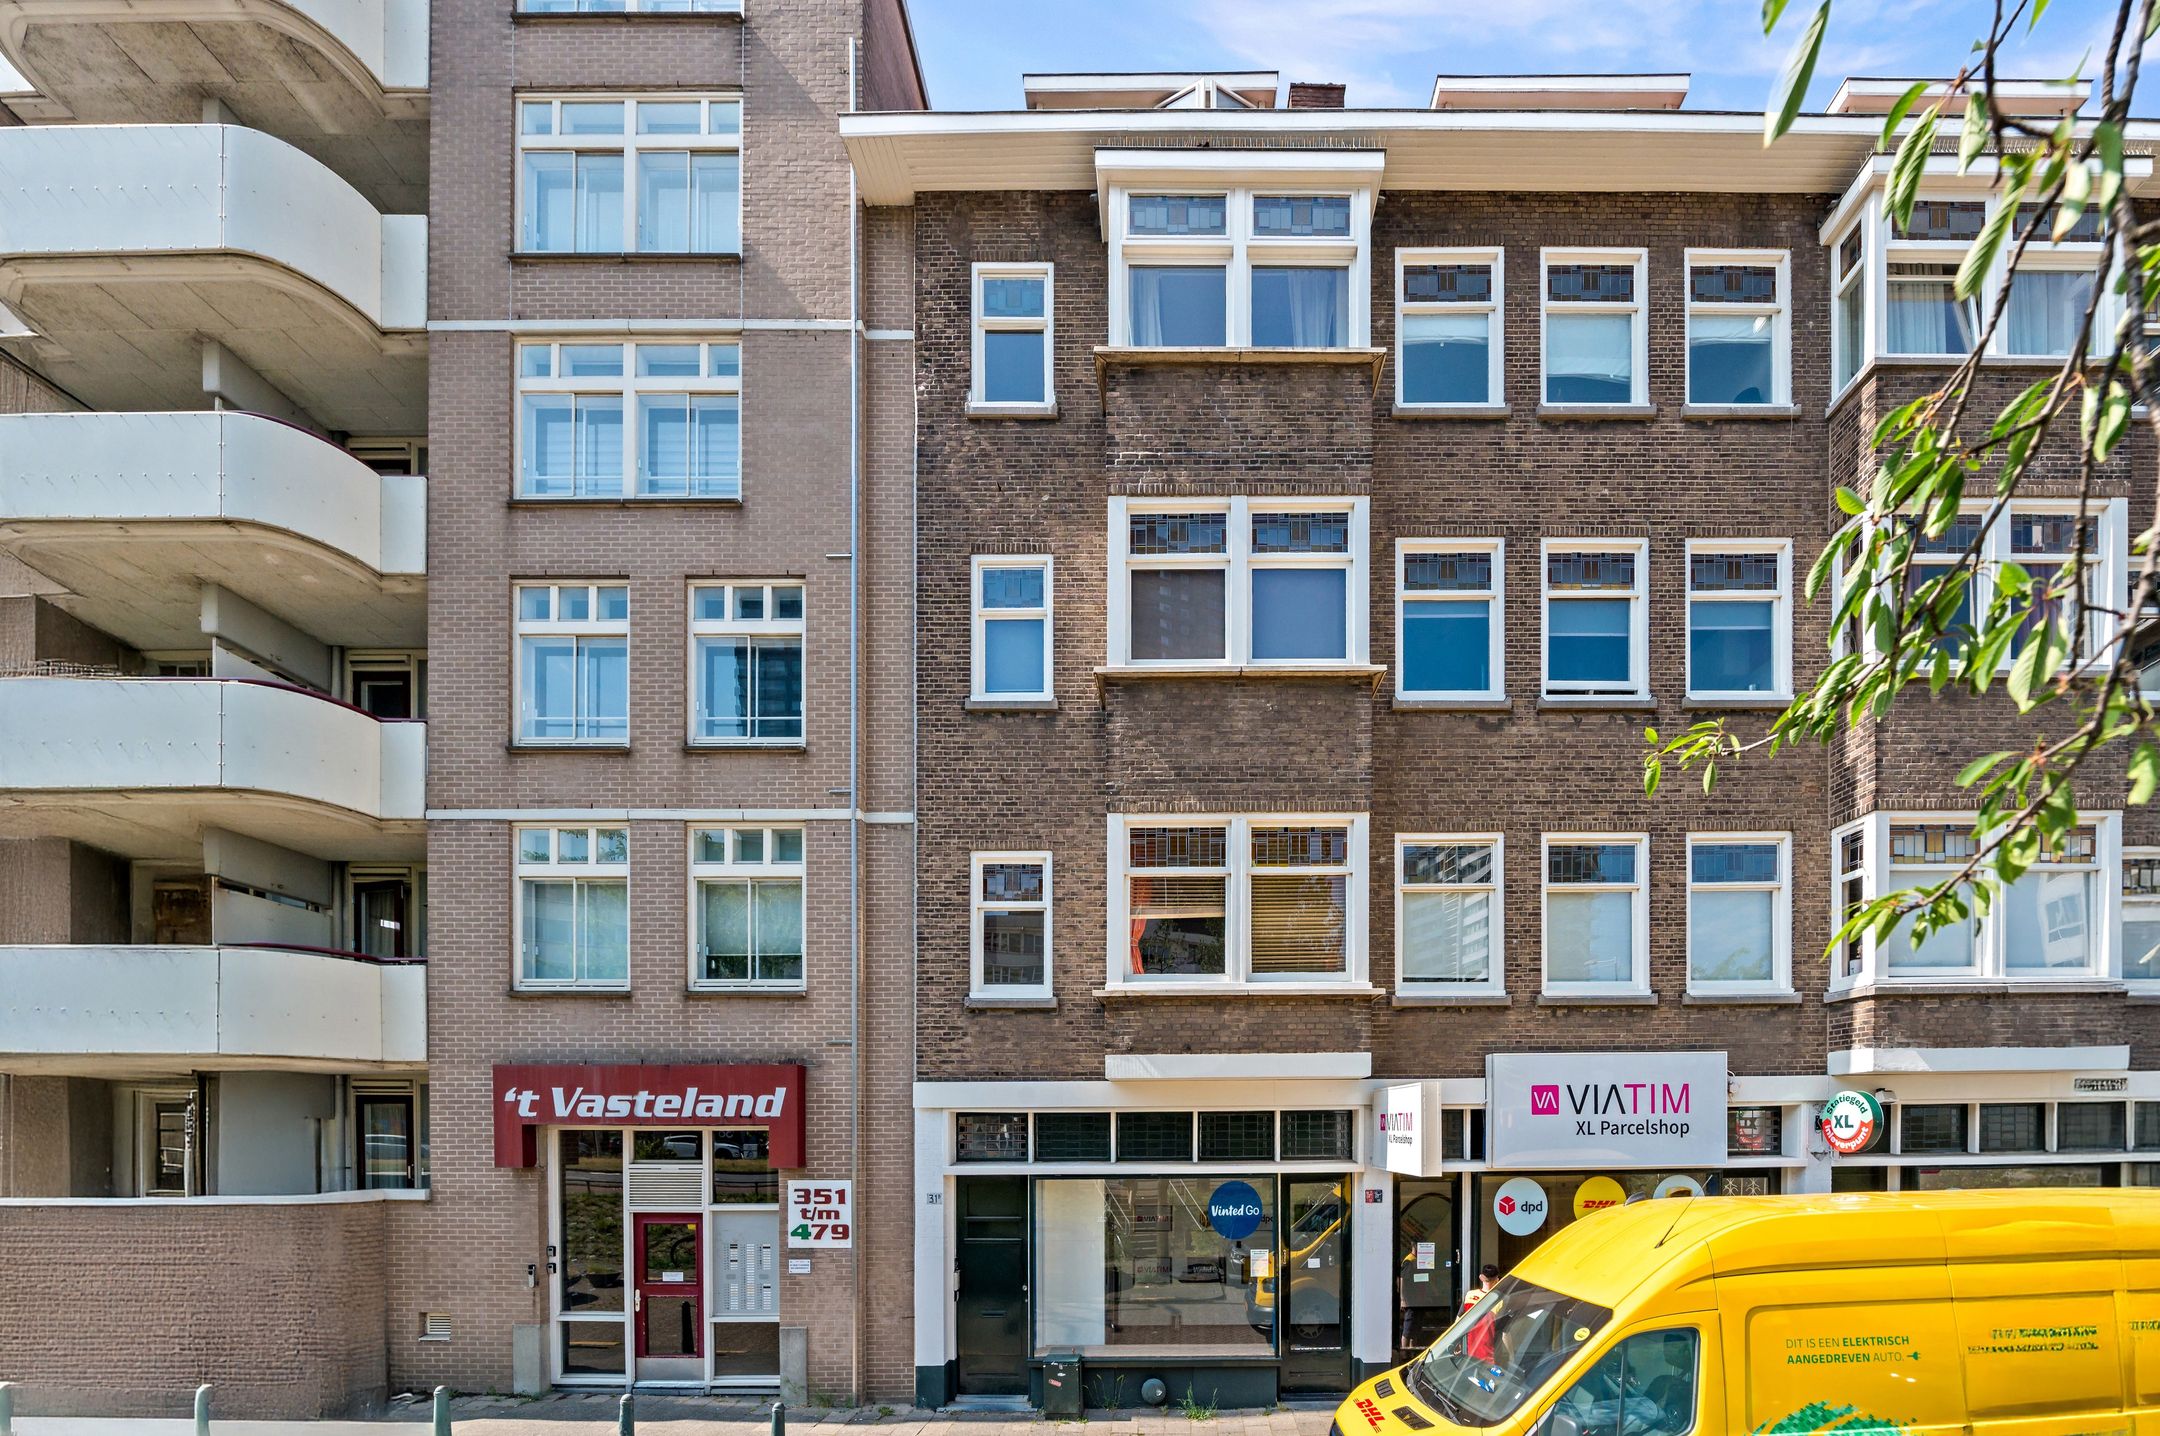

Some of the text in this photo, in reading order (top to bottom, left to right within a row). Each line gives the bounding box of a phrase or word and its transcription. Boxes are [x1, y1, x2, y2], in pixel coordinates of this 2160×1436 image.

[551, 1087, 787, 1118] Vasteland
[1566, 1083, 1690, 1115] VIATIM
[1826, 1094, 1868, 1115] Statiegeld
[1386, 1112, 1413, 1132] VIATIM
[1576, 1119, 1690, 1139] XL Parcelshop
[1834, 1114, 1854, 1129] XL
[793, 1188, 846, 1205] 351
[800, 1206, 840, 1222] t/m
[1211, 1204, 1260, 1217] Vinted Go
[1520, 1200, 1543, 1215] dpd
[790, 1223, 850, 1240] 479
[1786, 1335, 1910, 1348] DIT IS EEN ELEKTRISCH
[1787, 1353, 1871, 1364] AANGEDREVEN
[1355, 1398, 1386, 1428] DHL
